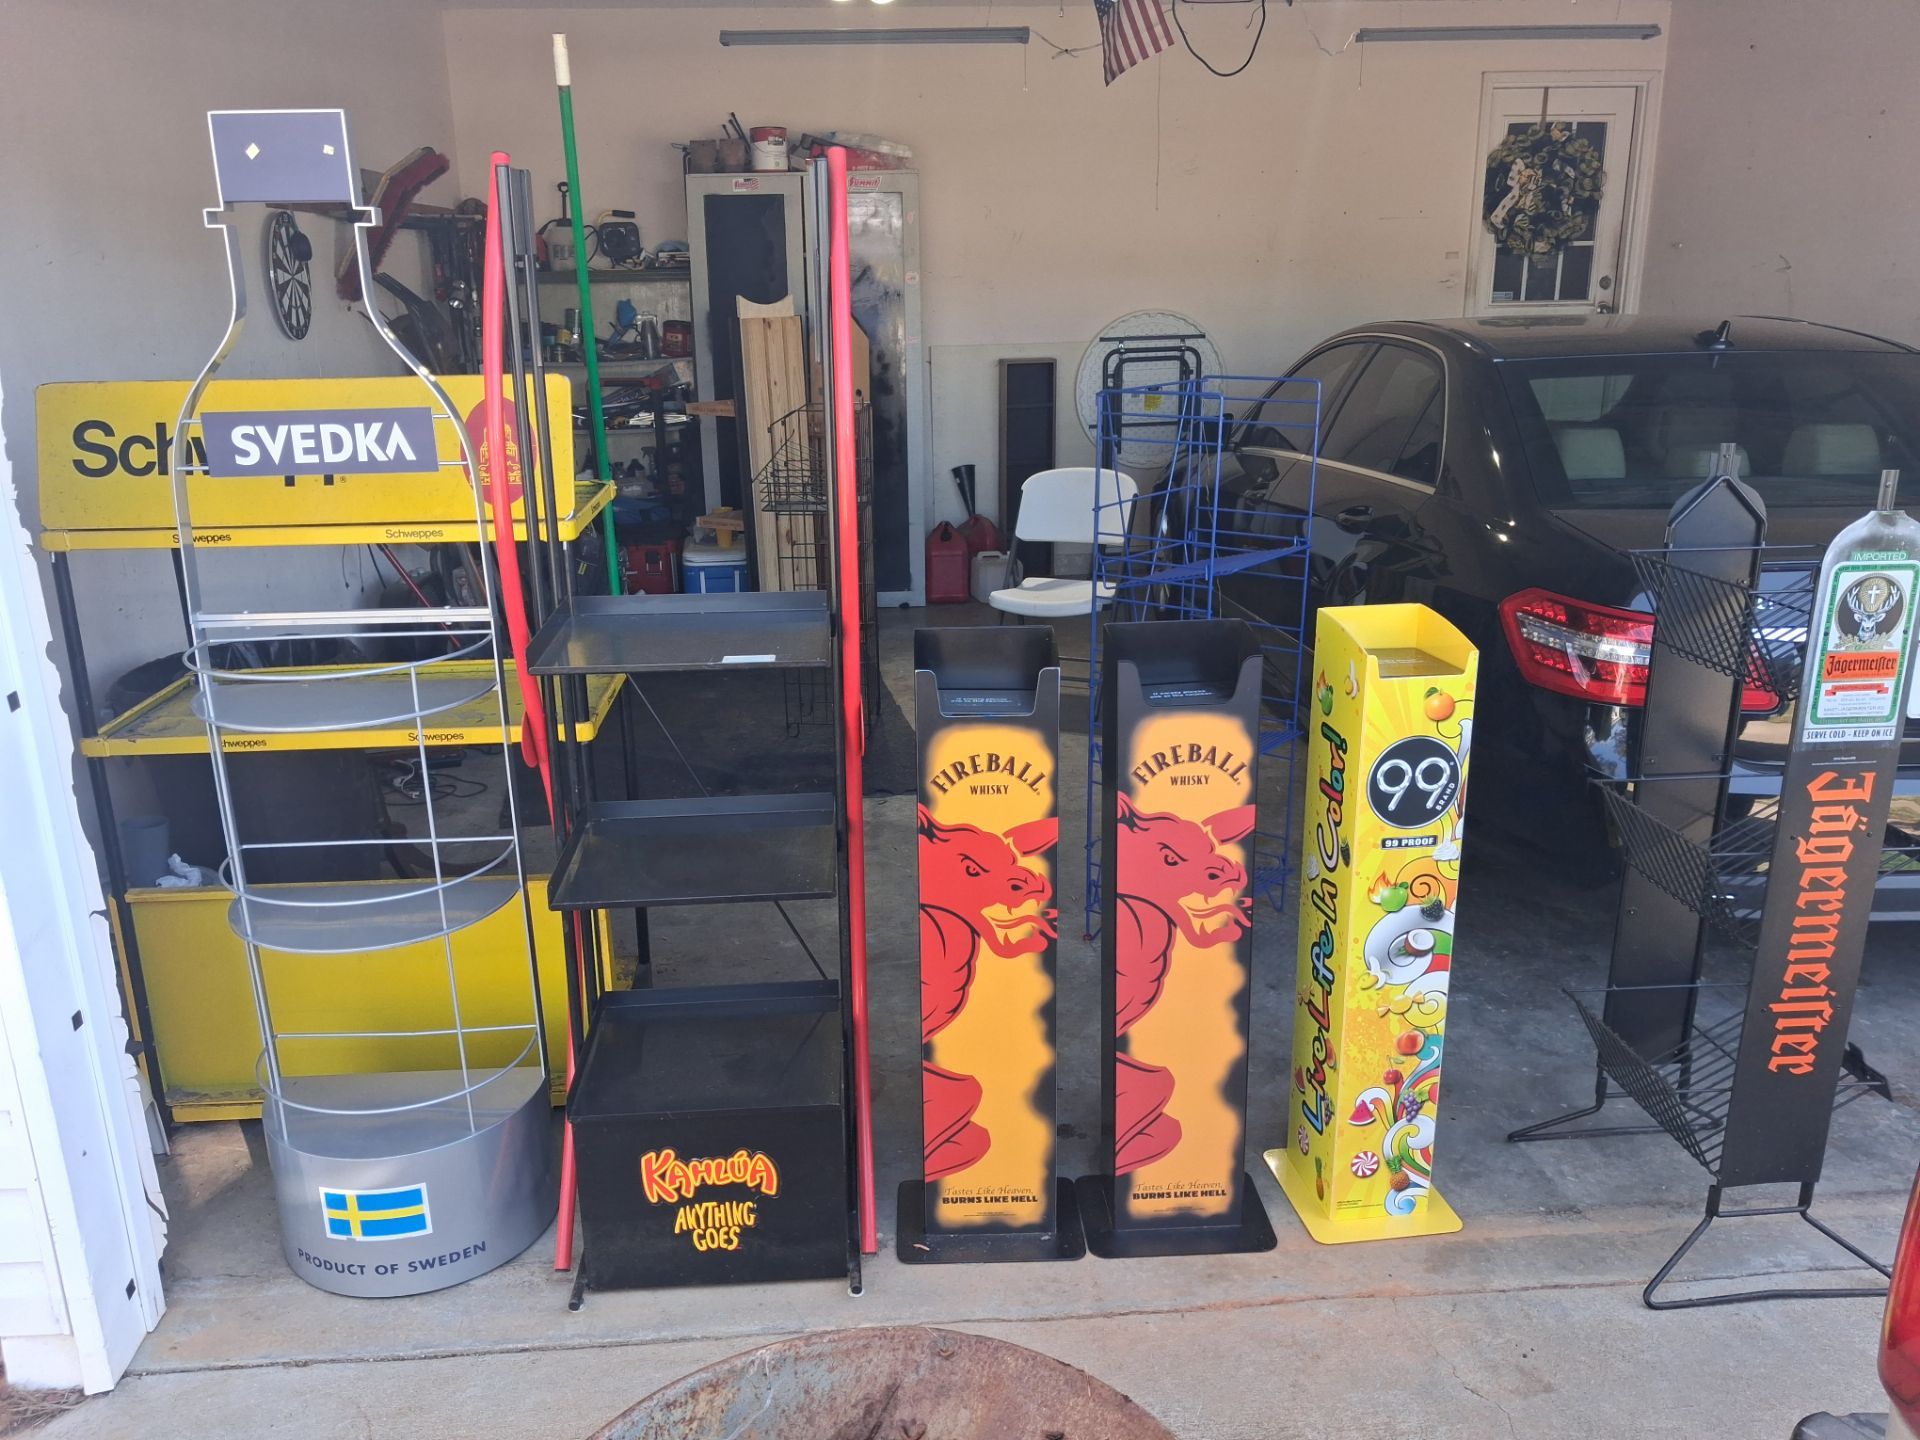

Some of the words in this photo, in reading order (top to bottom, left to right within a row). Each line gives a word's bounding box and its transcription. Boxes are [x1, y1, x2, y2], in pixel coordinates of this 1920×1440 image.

[230, 421, 417, 466] SVEDKA
[172, 533, 232, 544] Sweppes
[385, 528, 444, 539] Schweppes
[1853, 552, 1907, 561] IMPORTED
[1806, 730, 1828, 740] SERVE
[1829, 730, 1846, 739] COLD
[1853, 729, 1870, 738] KEEP
[1871, 729, 1881, 737] ON
[1882, 728, 1893, 737] ICE
[930, 752, 1046, 794] FIREBALL
[1131, 743, 1247, 786] FIREBALL
[970, 785, 1009, 795] WHISKY
[1170, 774, 1210, 786] WHISKY
[1376, 757, 1451, 811] 99
[1317, 721, 1348, 873] Color!
[1435, 782, 1456, 811] BRAND
[1385, 839, 1399, 848] 99
[1401, 837, 1435, 847] PROOF
[1308, 919, 1335, 1033] Life
[1302, 1026, 1327, 1136] Live
[641, 1149, 778, 1203] KAHLÚA
[1136, 1183, 1163, 1191] Tastes
[1167, 1181, 1185, 1190] Like
[942, 1196, 983, 1204] BURNS
[984, 1196, 1009, 1204] LIKE
[1011, 1195, 1038, 1203] HELL
[944, 1187, 973, 1195] Tastes
[976, 1185, 995, 1195] Like
[1132, 1191, 1172, 1200] BURNS
[1174, 1190, 1199, 1199] LIKE
[1200, 1189, 1227, 1197] HELL
[674, 1200, 757, 1234] ANYTHING
[692, 1226, 741, 1251] GOES
[297, 1247, 366, 1276] PRODUCT
[374, 1263, 400, 1276] OF
[407, 1241, 487, 1273] SWEDEN
